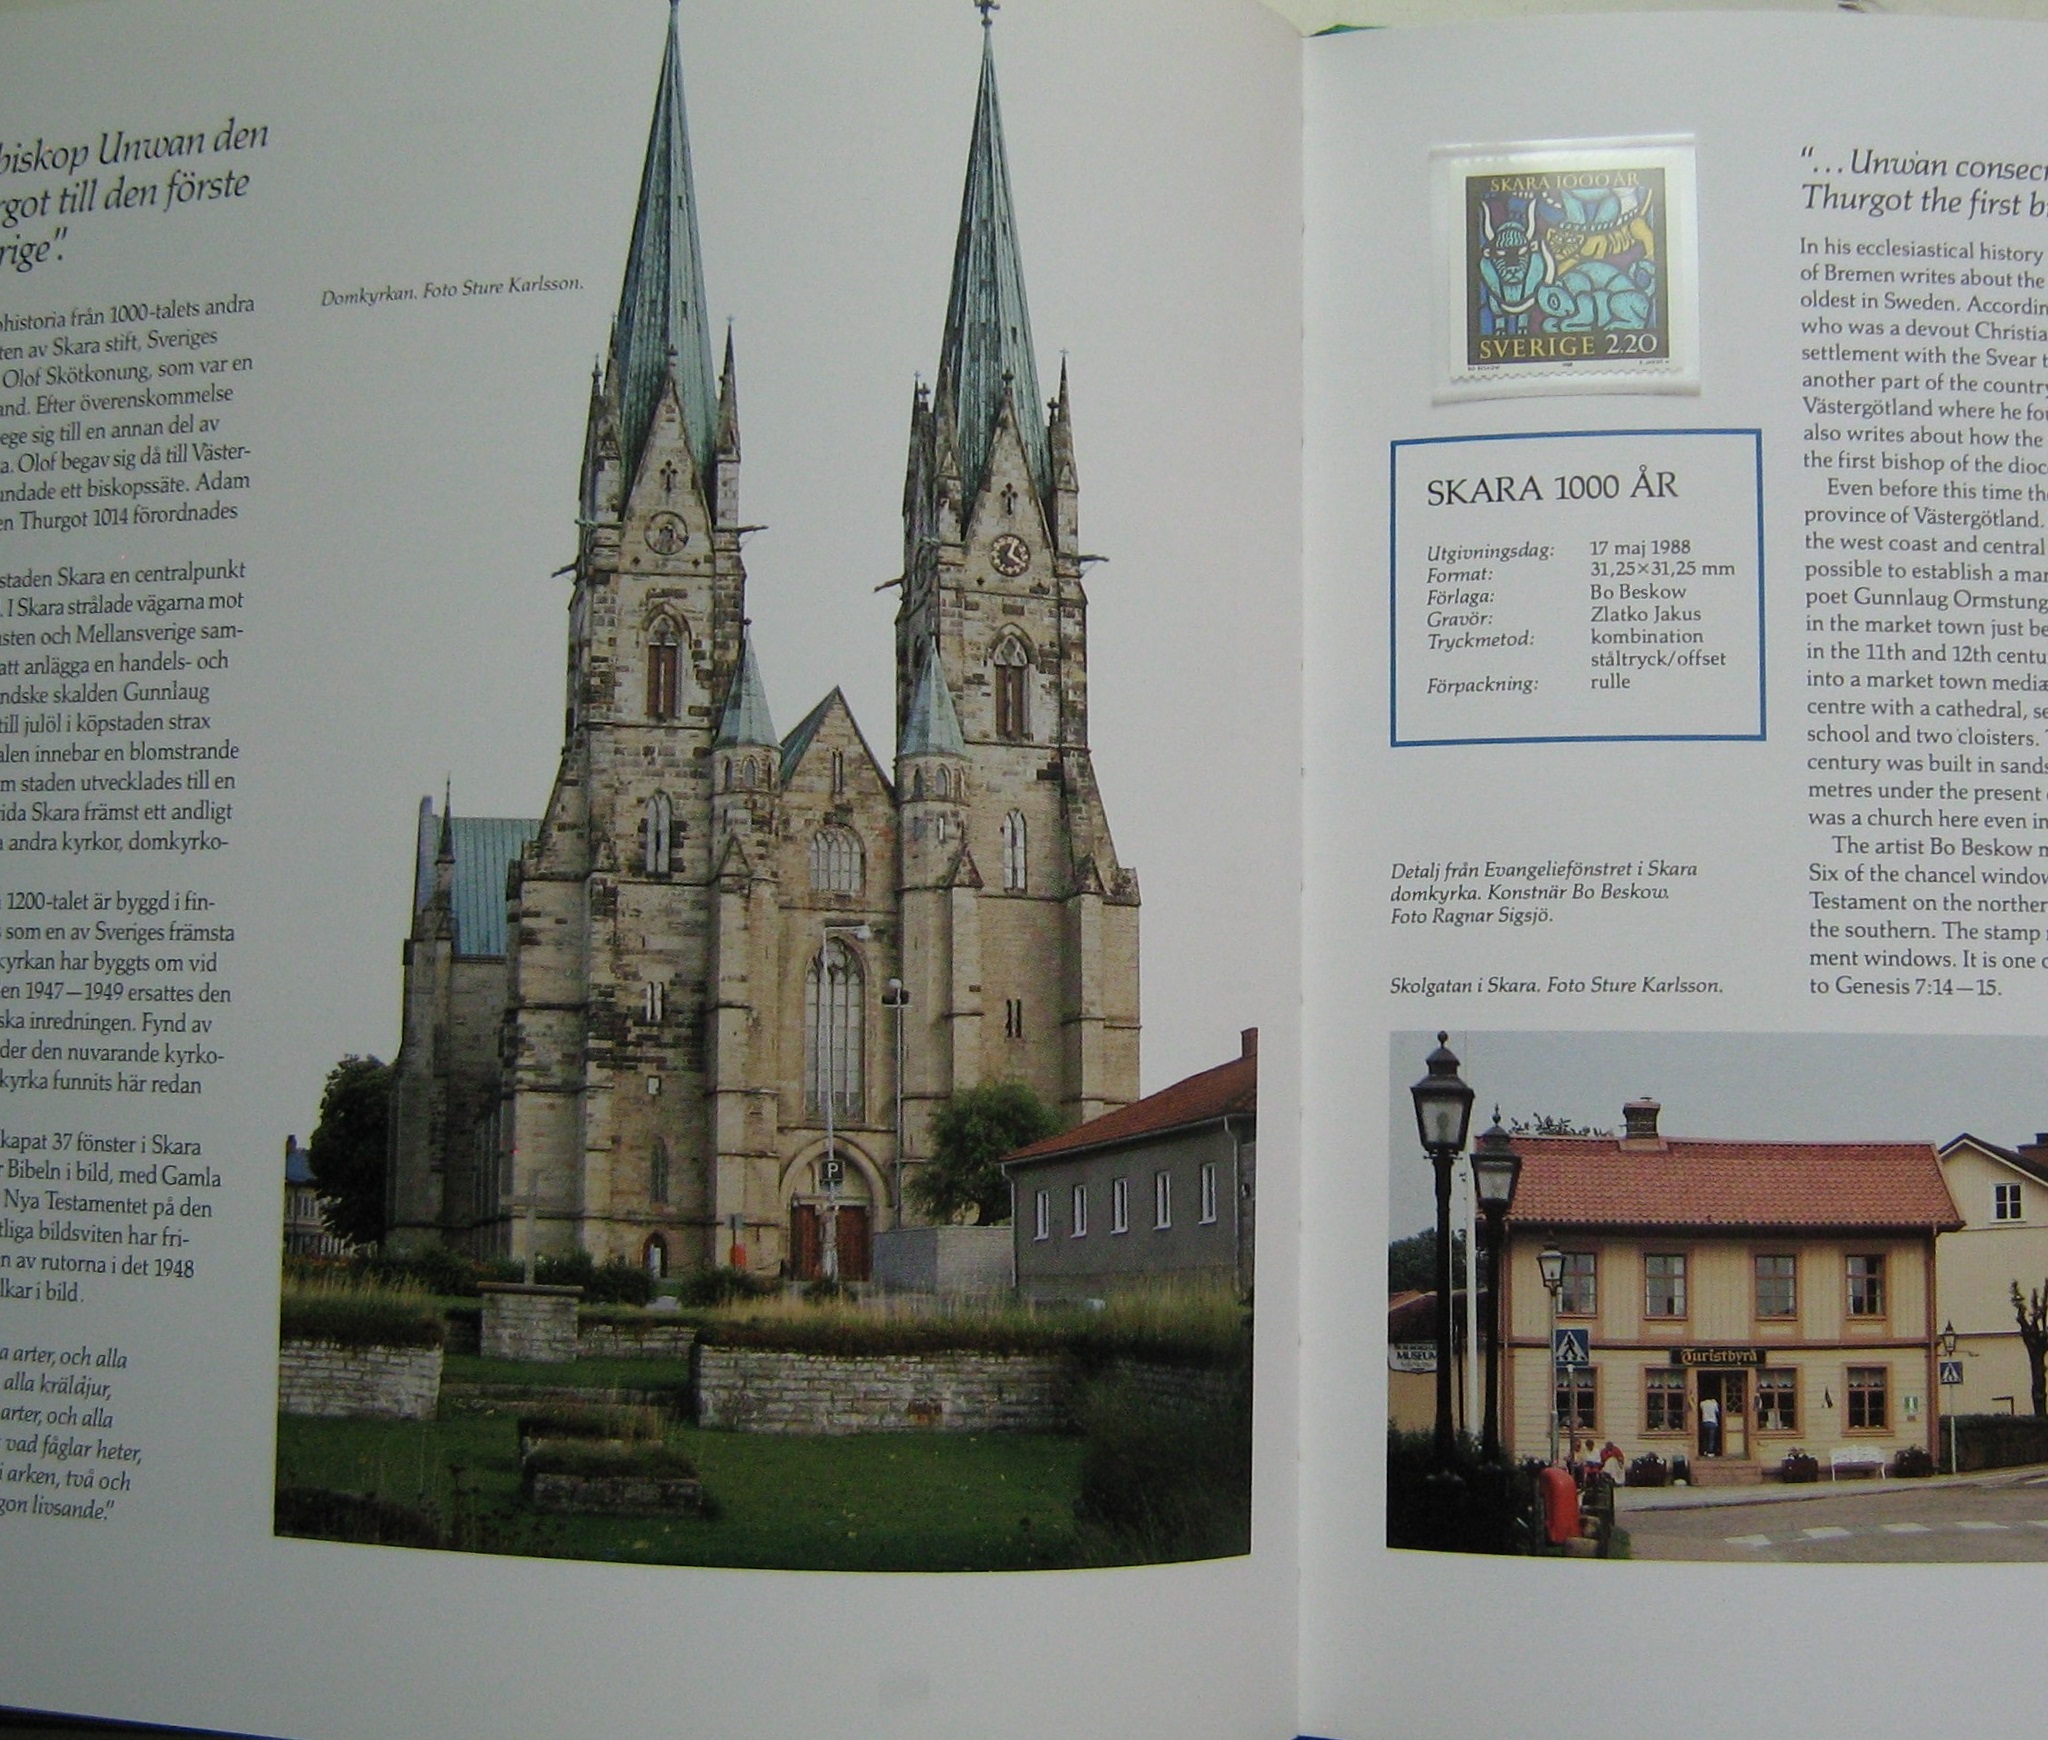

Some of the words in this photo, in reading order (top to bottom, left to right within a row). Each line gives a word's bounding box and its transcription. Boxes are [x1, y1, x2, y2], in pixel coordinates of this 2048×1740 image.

[99, 132, 205, 165] Unwan
[213, 118, 269, 153] den
[59, 179, 98, 215] till
[103, 175, 157, 210] den
[166, 169, 250, 209] förste
[1491, 175, 1550, 192] SKARA
[1557, 173, 1610, 189] 1000
[1614, 170, 1640, 187] ÅR
[1801, 183, 1913, 217] Thurgot
[1921, 186, 1962, 213] the
[1968, 188, 2022, 221] first
[1800, 237, 1819, 255] In
[1824, 237, 1852, 255] his
[1855, 238, 1975, 259] ecclesiastical
[1979, 242, 2044, 267] history
[1800, 263, 1820, 281] of
[1824, 264, 1895, 283] Bremen
[1899, 268, 1956, 285] writes
[1960, 268, 2013, 287] about
[2017, 271, 2045, 289] the
[321, 286, 417, 307] Domkyrkan.
[423, 283, 458, 299] Foto
[461, 280, 505, 297] Sture
[507, 275, 584, 294] Karlsson.
[70, 308, 105, 327] från
[110, 300, 201, 324] 1000-talets
[204, 294, 255, 316] andra
[27, 346, 48, 359] av
[52, 336, 101, 357] Skara
[104, 332, 142, 353] stift,
[147, 329, 218, 351] Sveriges
[1479, 336, 1595, 359] SVERIGE
[1605, 333, 1658, 354] 2.20
[35, 395, 77, 415] Efter
[79, 383, 234, 412] överenskommelse
[1803, 423, 1842, 441] also
[1846, 426, 1905, 443] writes
[1909, 426, 1964, 445] about
[1969, 427, 2010, 446] how
[2015, 430, 2043, 448] the
[1427, 476, 1544, 507] SKARA
[1554, 475, 1620, 501] 1000
[1629, 465, 1679, 498] ÅR
[19, 511, 89, 533] Thurgot
[92, 508, 129, 527] 1014
[133, 500, 239, 525] förordnades
[1804, 507, 1887, 527] province
[1890, 506, 1909, 524] of
[1913, 507, 2045, 531] Västergötland.
[1427, 542, 1555, 565] Utgivningsdag:
[1589, 541, 1609, 556] 17
[1614, 540, 1646, 559] maj
[1651, 540, 1691, 555] 1988
[1805, 531, 1835, 550] the
[1839, 536, 1884, 551] west
[1888, 538, 1938, 552] coast
[1943, 535, 1978, 553] and
[1982, 538, 2045, 556] central
[57, 567, 106, 587] Skara
[109, 571, 131, 585] en
[134, 559, 247, 585] centralpunkt
[1426, 568, 1493, 584] Format:
[1701, 565, 1735, 576] mm
[1426, 588, 1495, 608] Förlaga:
[1590, 584, 1615, 601] Bo
[1619, 583, 1687, 600] Beskow
[1427, 611, 1493, 628] Gravör:
[1590, 606, 1649, 623] Zlatko
[1653, 605, 1702, 624] Jakus
[40, 625, 71, 646] och
[75, 622, 197, 646] Mellansverige
[200, 626, 244, 640] sam-
[1591, 628, 1705, 645] kombination
[1806, 615, 1825, 632] in
[1829, 614, 1860, 632] the
[1865, 615, 1933, 634] market
[1937, 620, 1985, 635] town
[1991, 619, 2024, 640] just
[1427, 630, 1535, 653] Tryckmetod:
[1591, 649, 1727, 670] ståltryck/offset
[1427, 676, 1539, 697] Förpackning:
[1591, 673, 1631, 689] rulle
[1807, 700, 1867, 715] centre
[1871, 698, 1915, 716] with
[1935, 699, 2028, 721] cathedral,
[34, 742, 101, 763] innebar
[103, 749, 125, 762] en
[129, 739, 240, 761] blomstrande
[1808, 814, 1846, 826] was
[1867, 808, 1934, 827] church
[1937, 809, 1979, 829] here
[1983, 816, 2027, 829] even
[1391, 862, 1441, 883] Detalj
[1443, 862, 1479, 883] från
[1483, 860, 1633, 881] Evangeliefönstret
[1647, 860, 1697, 877] Skara
[1390, 884, 1482, 905] domkyrka.
[1487, 884, 1568, 901] Konstnär
[1571, 884, 1595, 900] Bo
[1600, 883, 1669, 899] Beskow.
[1808, 892, 1907, 911] Testament
[1912, 899, 1938, 911] on
[1942, 893, 1972, 912] the
[1391, 908, 1428, 925] Foto
[1431, 908, 1495, 928] Ragnar
[1497, 906, 1553, 927] Sigsjö.
[5, 927, 41, 940] som
[45, 928, 66, 941] en
[69, 928, 91, 941] av
[95, 921, 165, 947] Sveriges
[168, 921, 235, 942] främsta
[1809, 952, 1859, 967] ment
[1863, 948, 1957, 968] windows.
[1963, 950, 1977, 968] It
[1982, 952, 1997, 968] is
[2001, 956, 2037, 969] one
[1389, 977, 1473, 998] Skolgatan
[1487, 977, 1541, 994] Skara.
[1547, 976, 1586, 993] Foto
[1590, 976, 1637, 993] Sture
[1641, 976, 1723, 993] Karlsson.
[1809, 979, 1830, 994] to
[1835, 976, 1911, 995] Genesis
[29, 1010, 137, 1036] inredningen.
[141, 1012, 187, 1037] Fynd
[191, 1020, 213, 1034] av
[51, 1133, 73, 1151] 37
[77, 1132, 137, 1154] fönster
[151, 1134, 201, 1156] Skara
[828, 1162, 839, 1178] P
[38, 1220, 123, 1244] bildsviten
[127, 1224, 159, 1246] har
[161, 1226, 190, 1248] fri-
[15, 1256, 37, 1269] av
[41, 1256, 107, 1274] rutorna
[121, 1255, 149, 1276] det
[154, 1259, 195, 1279] 1948
